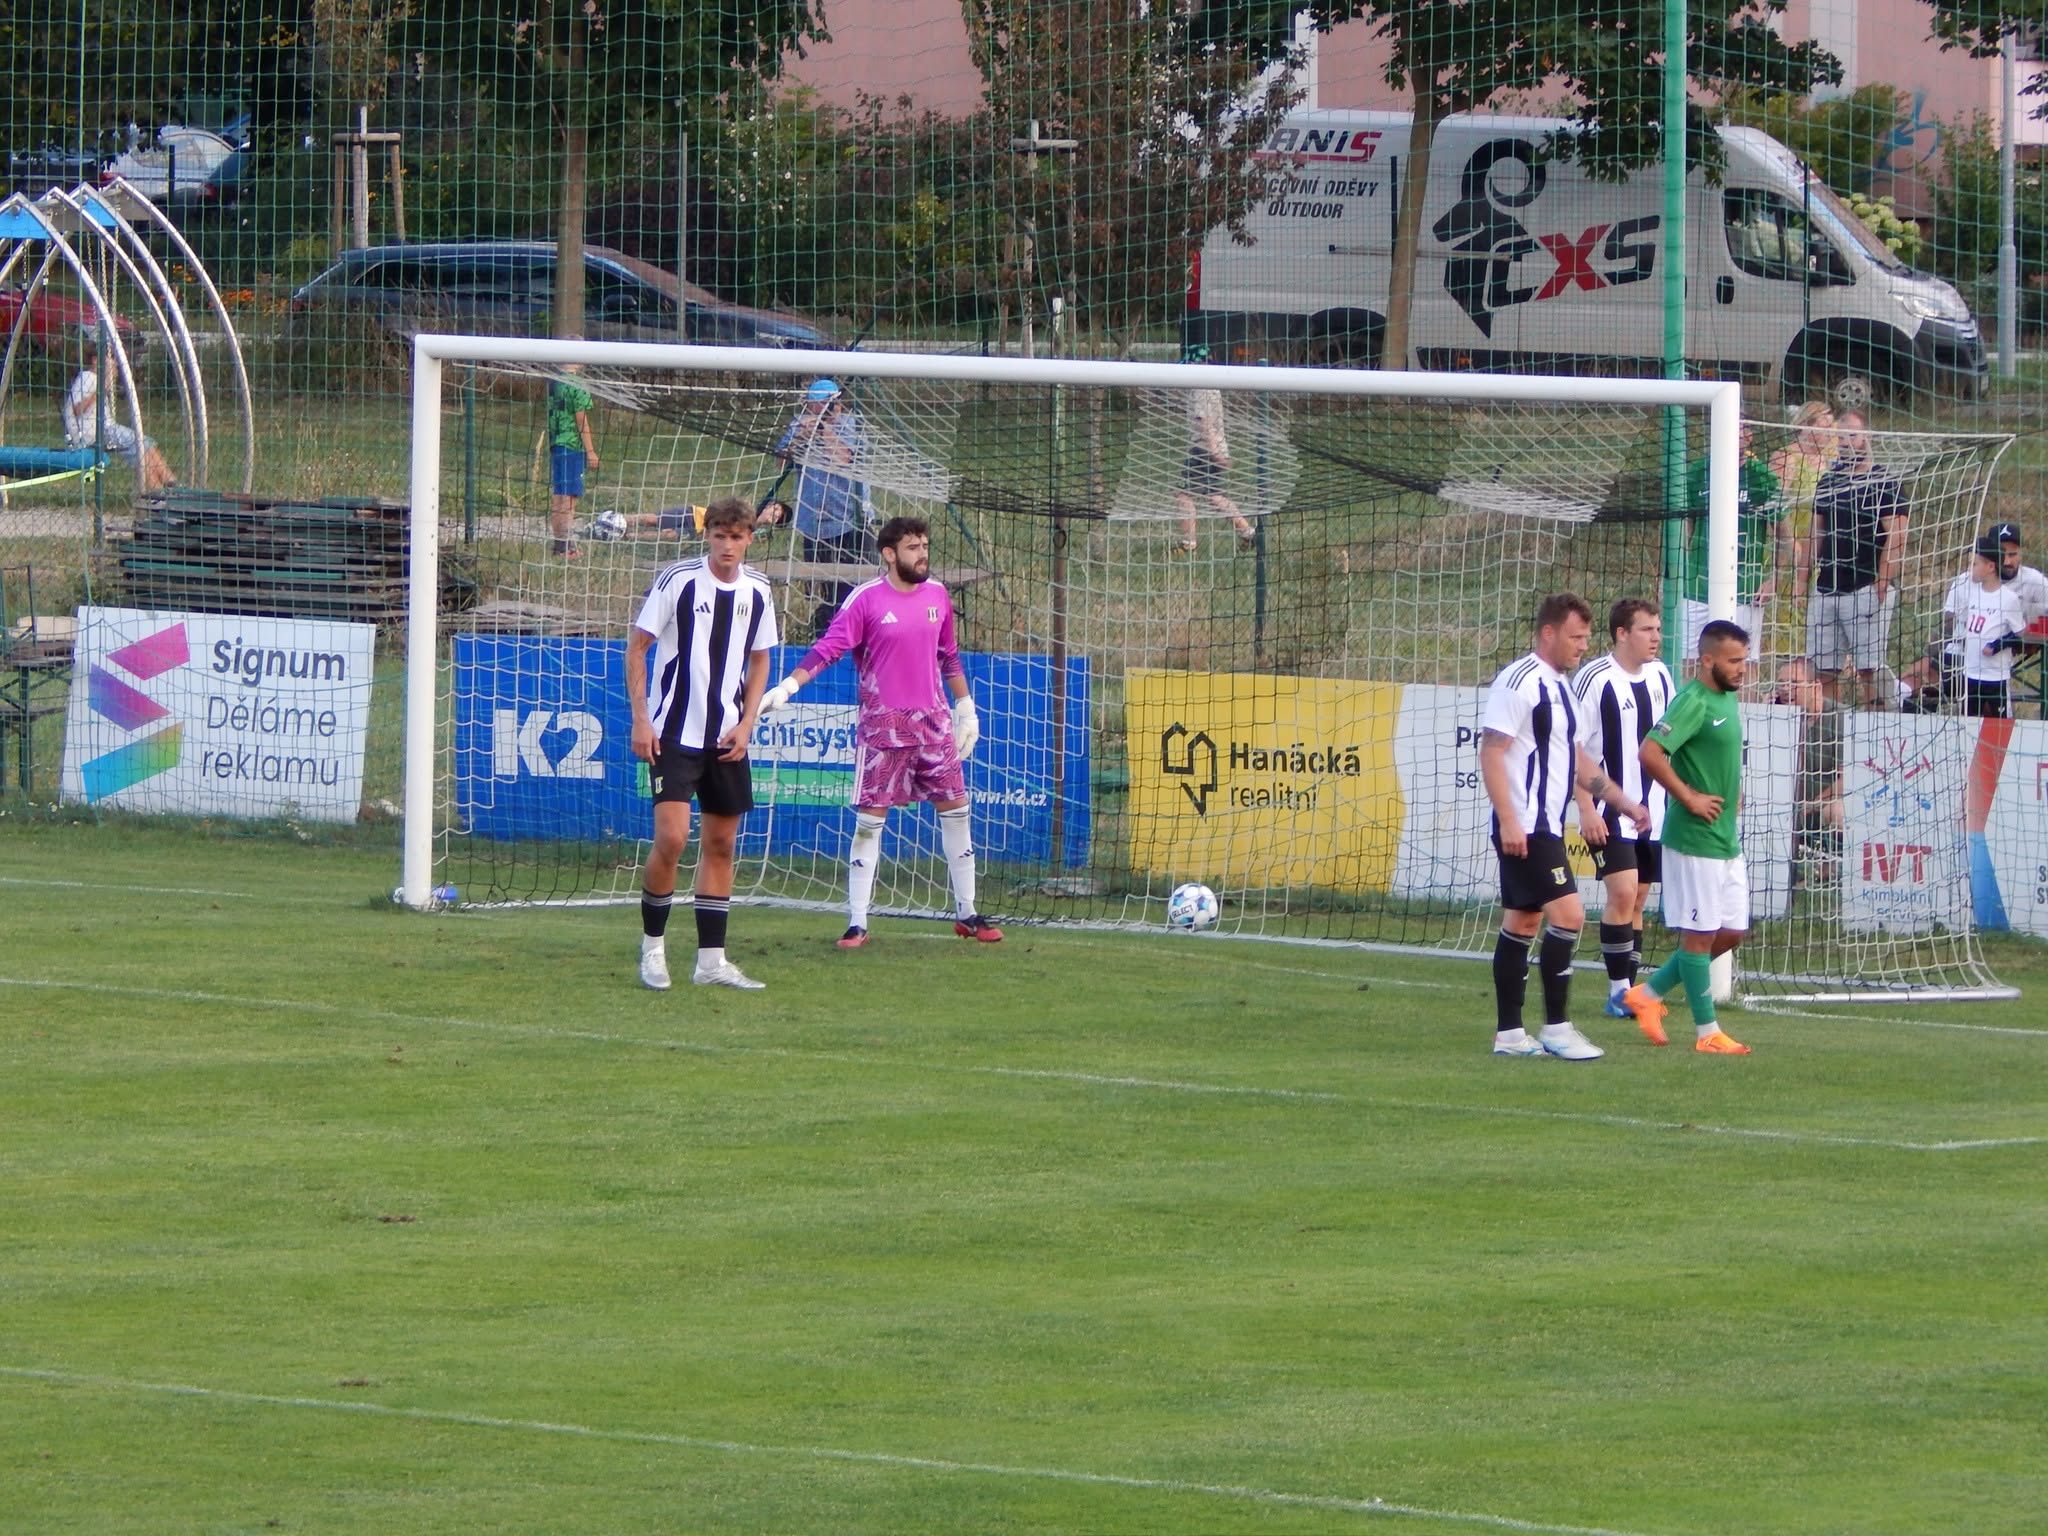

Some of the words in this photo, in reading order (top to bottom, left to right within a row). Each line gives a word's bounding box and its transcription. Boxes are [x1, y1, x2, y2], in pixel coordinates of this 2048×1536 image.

[1266, 128, 1382, 162] ANIS
[1266, 176, 1320, 195] COVNÍ
[1324, 178, 1379, 197] ODĚVY
[1268, 201, 1344, 219] OUTDOOR
[1489, 214, 1661, 302] CXS
[1968, 614, 1985, 634] 10
[212, 636, 345, 687] Signum
[207, 695, 337, 737] Děláme
[495, 709, 605, 779] K2
[803, 722, 858, 757] syst
[202, 744, 338, 786] reklamu
[1231, 782, 1317, 811] realitní
[1862, 842, 1932, 884] IVT
[1692, 908, 1698, 922] 2
